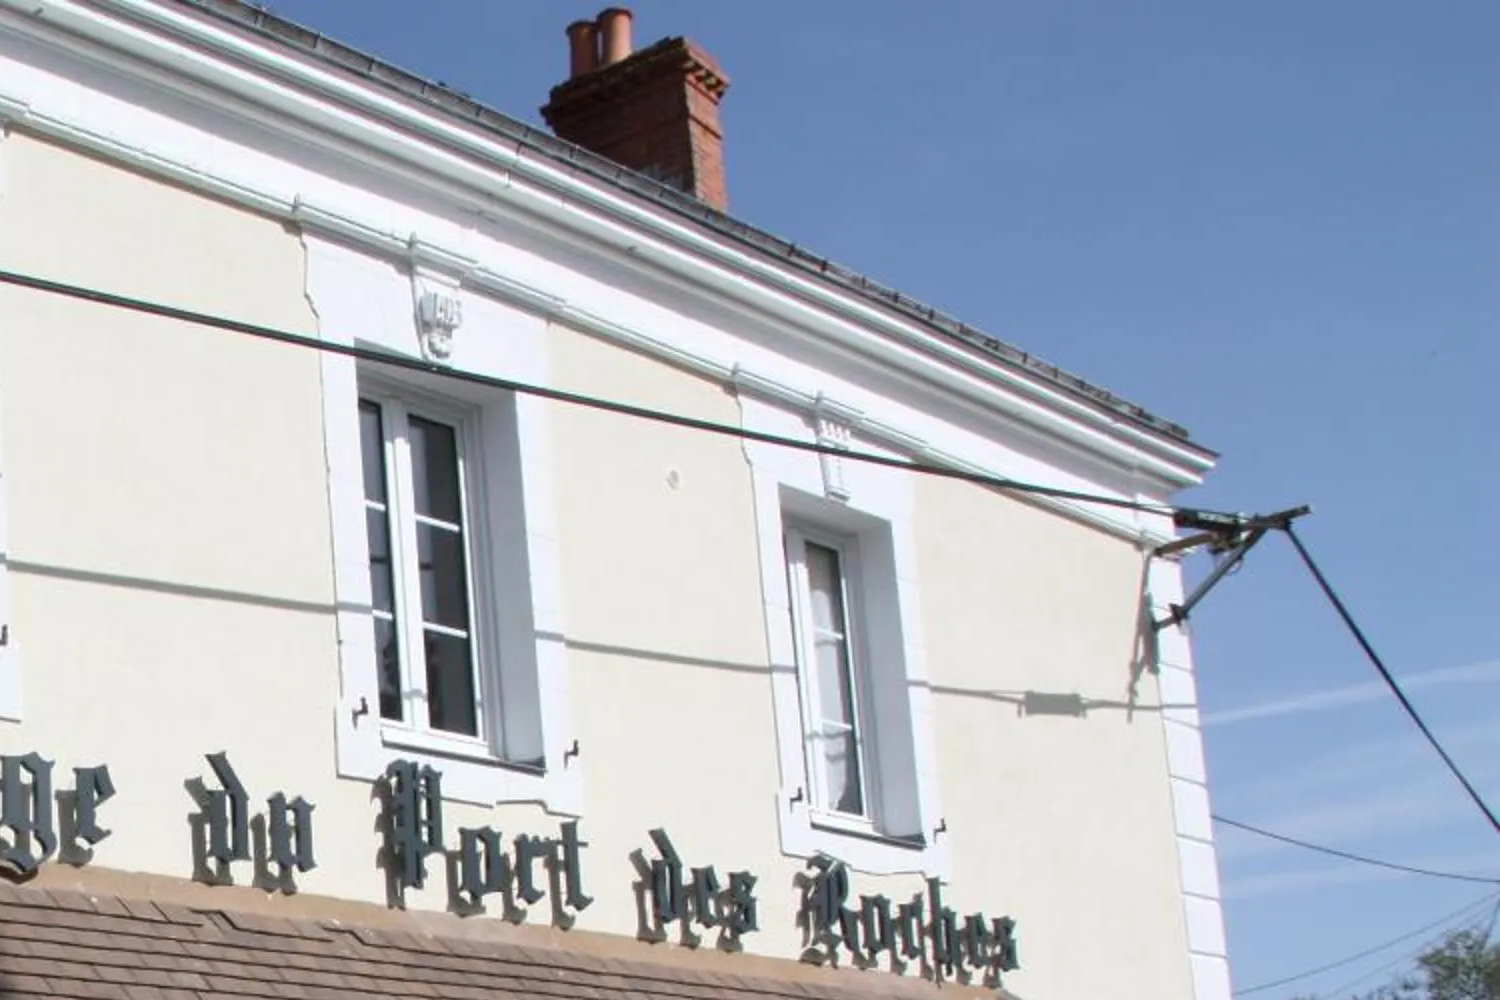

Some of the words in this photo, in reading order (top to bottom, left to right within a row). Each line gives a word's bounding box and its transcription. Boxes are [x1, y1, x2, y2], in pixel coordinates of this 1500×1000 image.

[204, 750, 318, 873] du
[384, 759, 594, 911] Port
[648, 827, 759, 934] des
[805, 854, 1020, 976] Roches
